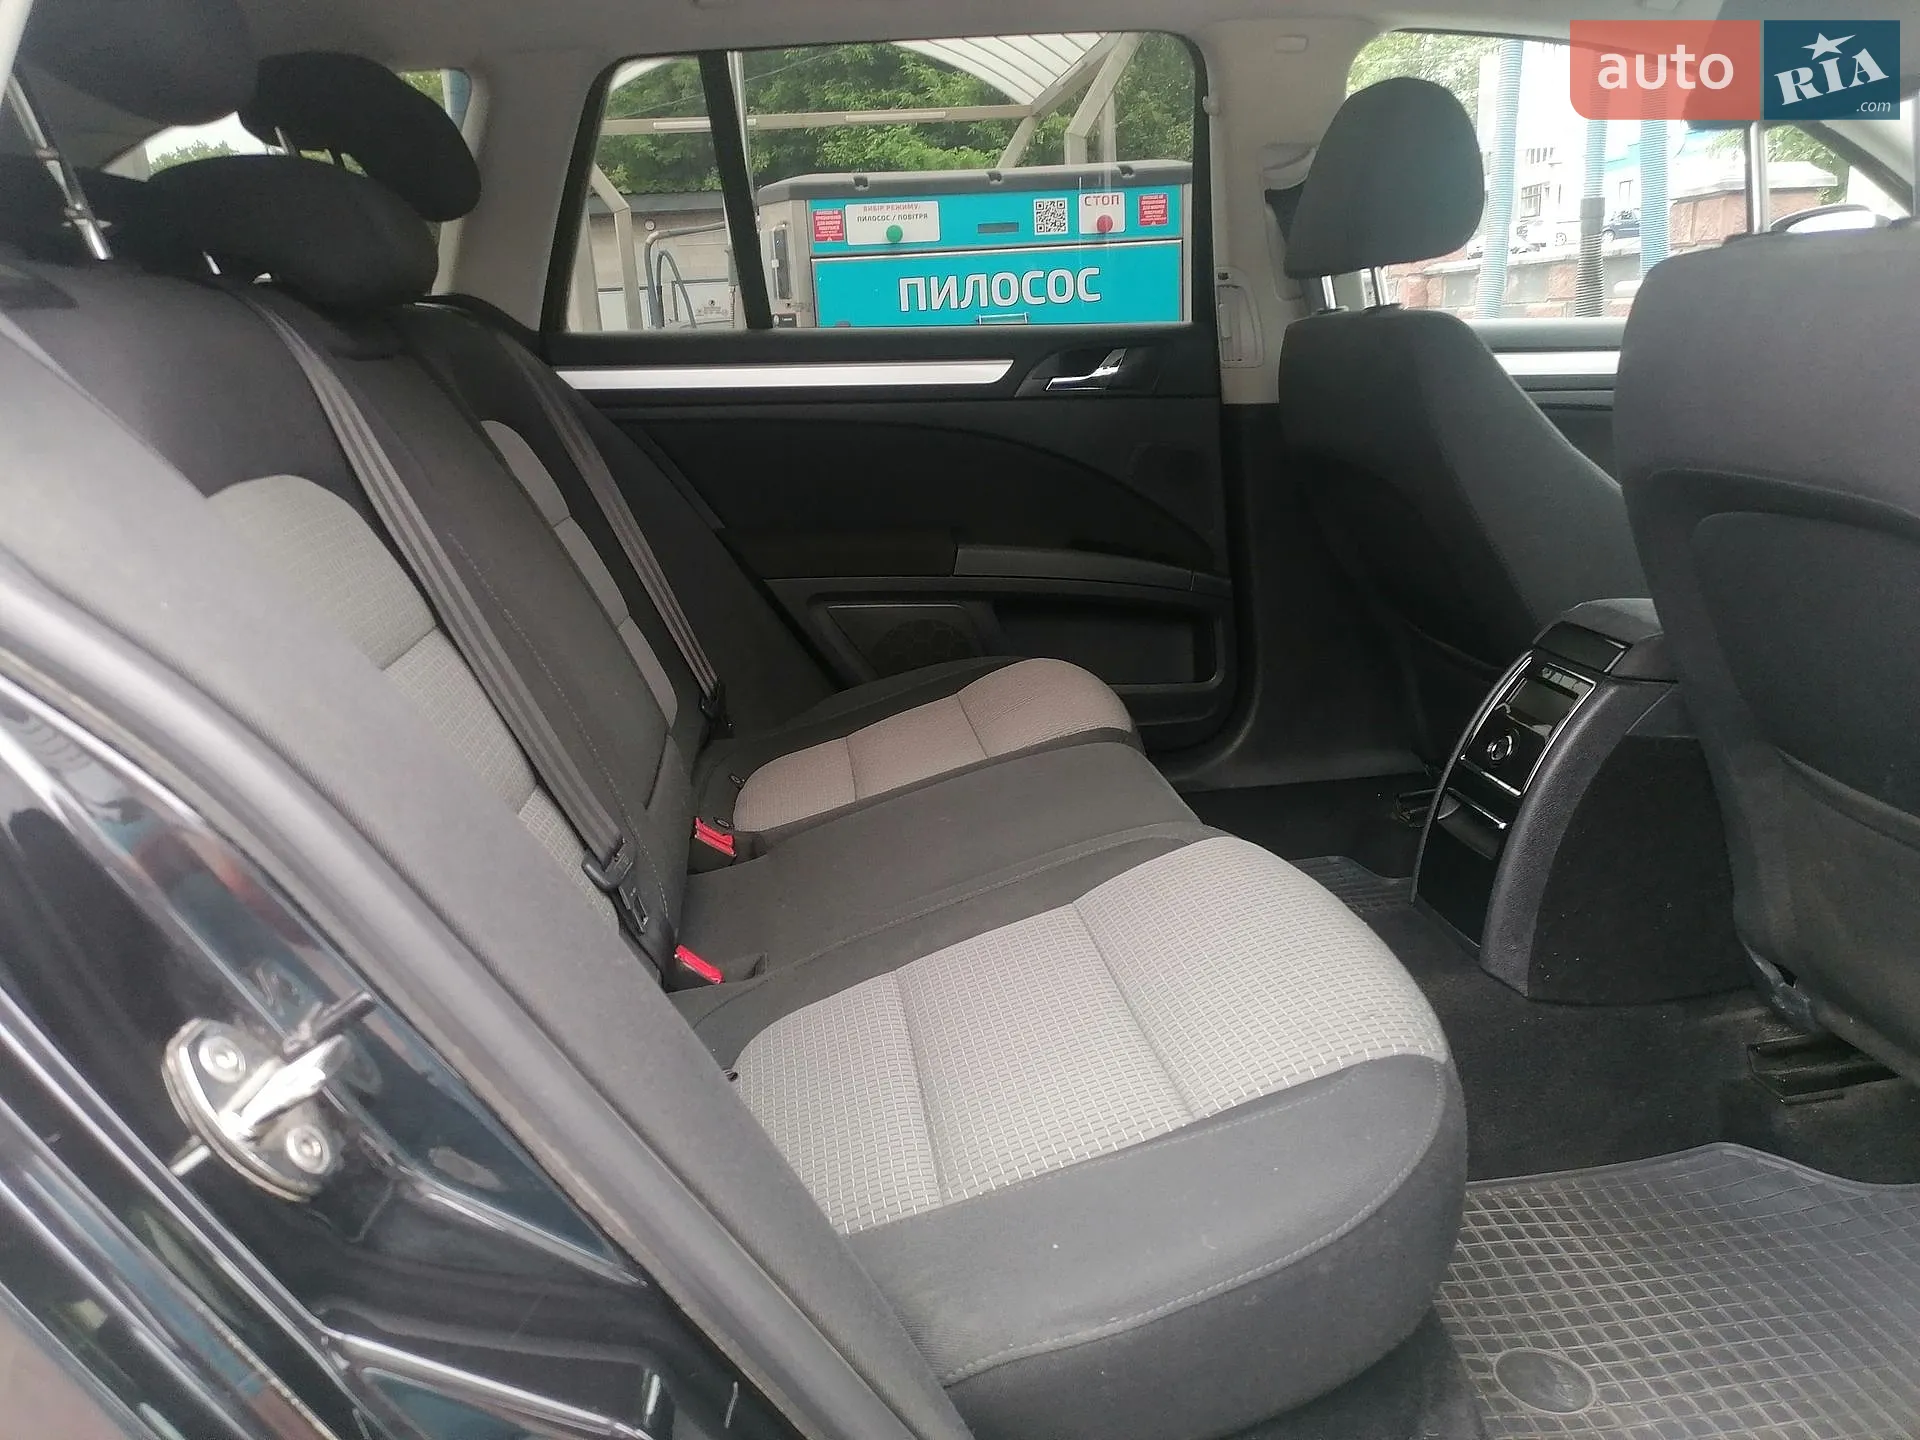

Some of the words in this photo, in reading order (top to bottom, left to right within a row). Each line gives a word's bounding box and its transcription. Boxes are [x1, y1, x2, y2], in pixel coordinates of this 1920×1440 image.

[1084, 194, 1120, 207] СТОП
[857, 214, 890, 223] ПИЛОСОС
[897, 212, 928, 221] ПОВІТРЯ
[898, 266, 1102, 312] ПИЛОСОС
